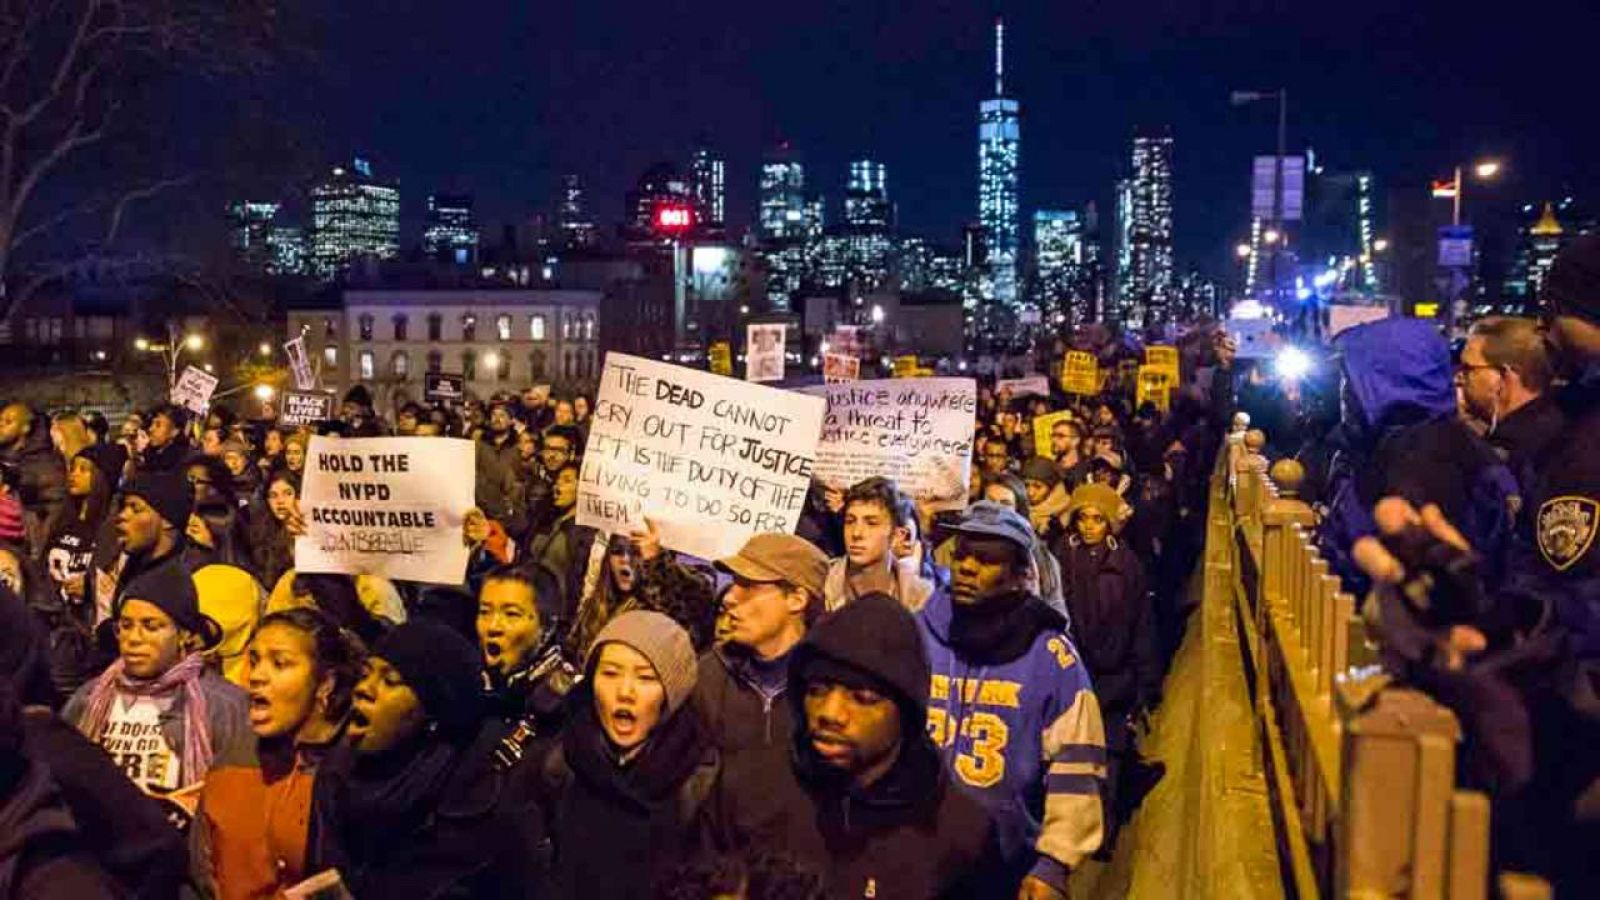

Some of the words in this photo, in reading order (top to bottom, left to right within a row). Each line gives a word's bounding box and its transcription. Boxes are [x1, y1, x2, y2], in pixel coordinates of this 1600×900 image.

[289, 395, 324, 408] BLACK
[290, 405, 321, 416] LIVES
[611, 364, 650, 396] THE
[655, 379, 705, 409] DEAD
[713, 399, 793, 435] CANNOT
[825, 388, 889, 414] justice
[896, 389, 975, 419] anywhere
[848, 410, 907, 431] threat
[912, 412, 932, 435] to
[596, 400, 632, 430] CRY
[643, 415, 692, 450] OUT
[700, 425, 738, 456] FOR
[739, 436, 815, 478] JUSTICE
[318, 453, 363, 473] HOLD
[370, 454, 409, 473] THE
[585, 435, 624, 459] IT
[634, 444, 651, 465] IS
[651, 449, 684, 474] THE
[689, 460, 739, 489] DUTY
[739, 476, 763, 500] OF
[758, 479, 806, 510] THE
[338, 483, 390, 501] NYPD
[582, 463, 650, 497] LIVING
[664, 487, 689, 507] TO
[697, 500, 722, 516] DO
[727, 504, 751, 524] SO
[754, 511, 787, 533] FOR
[312, 507, 435, 528] ACCOUNTABLE
